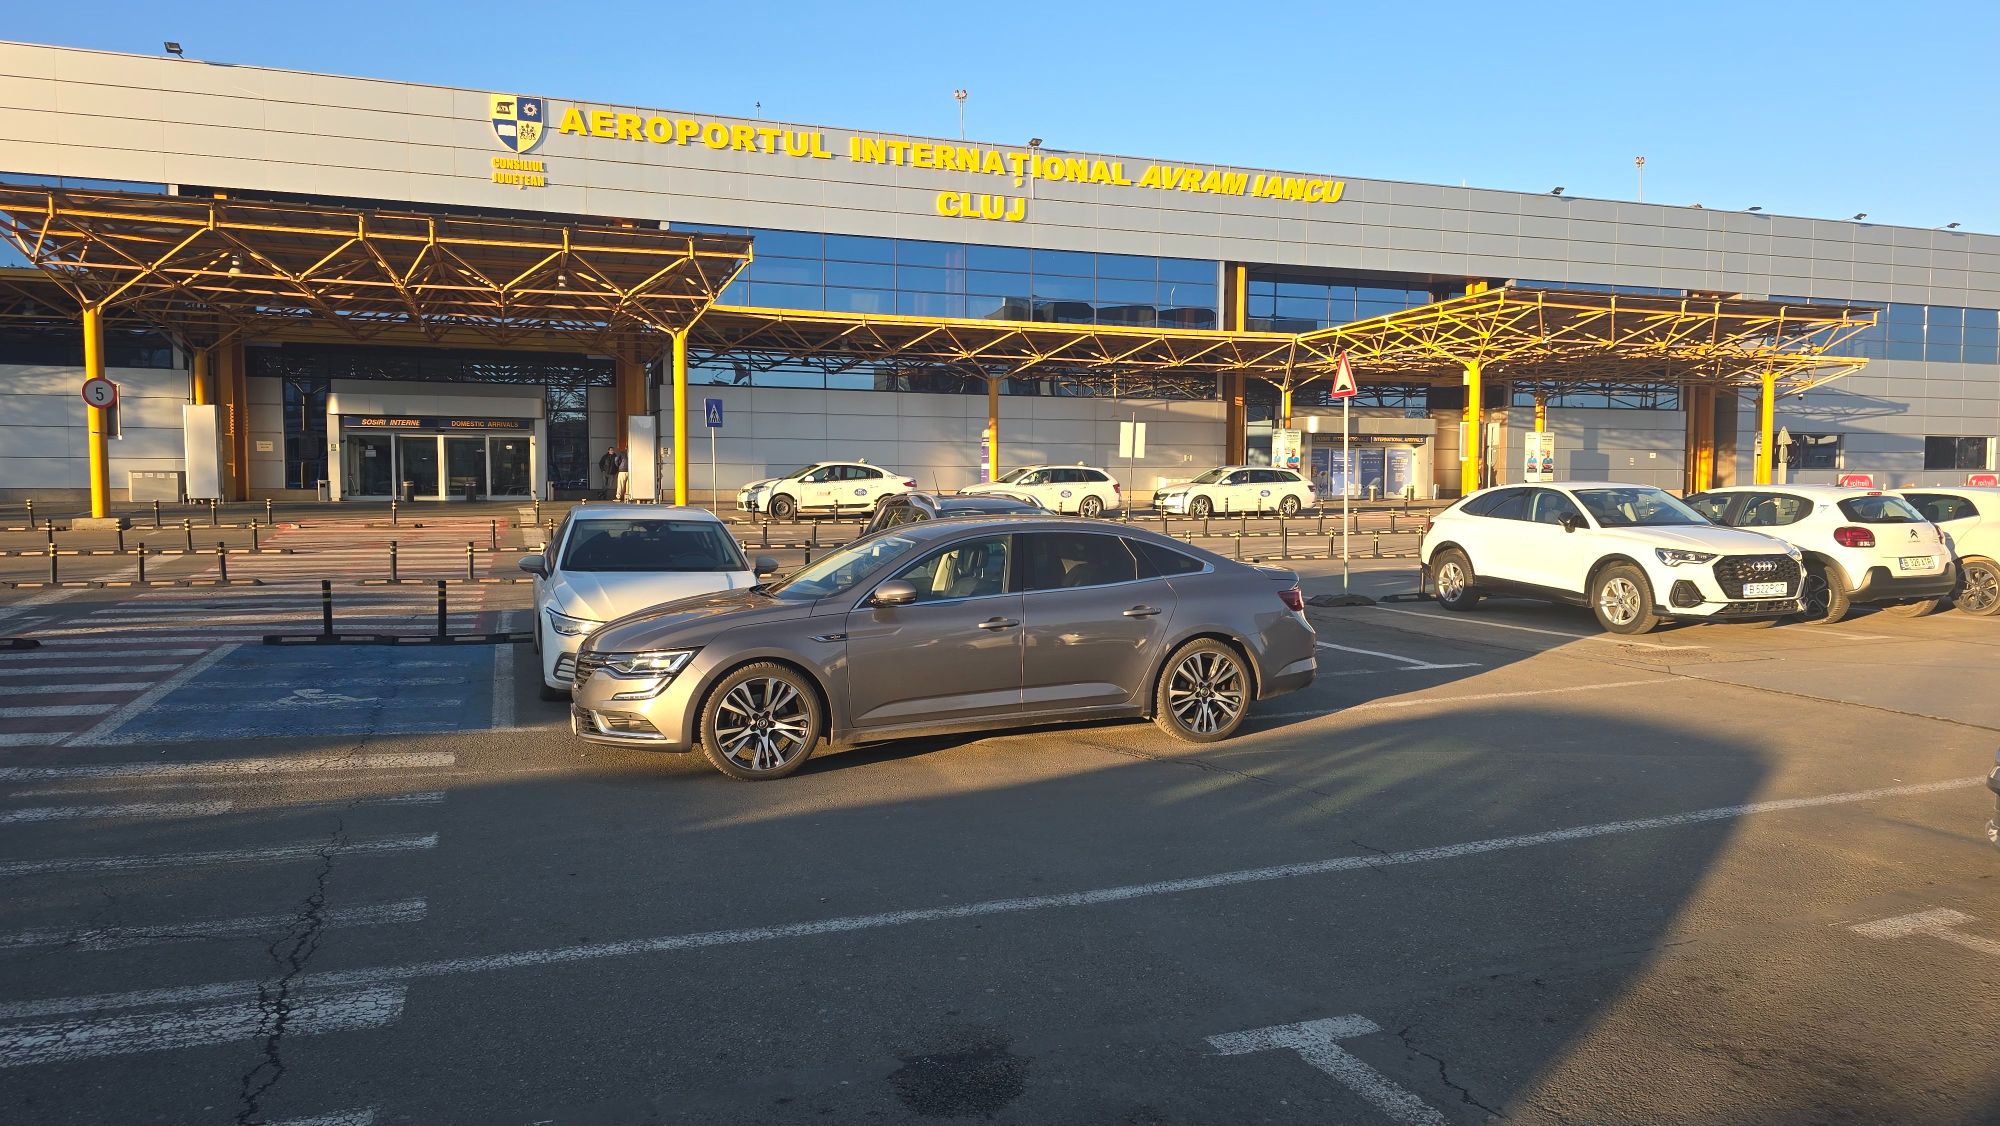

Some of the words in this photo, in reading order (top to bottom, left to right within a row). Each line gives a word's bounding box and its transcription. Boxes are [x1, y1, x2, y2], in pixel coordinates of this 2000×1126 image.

[559, 107, 832, 160] AEROPORTUL
[1137, 165, 1249, 197] AVRAM
[1252, 174, 1345, 204] IANCU
[491, 157, 545, 173] CONSILIUL
[936, 191, 1026, 222] CLUJ
[95, 387, 104, 401] 5
[361, 418, 387, 426] SOSIRI
[389, 419, 421, 427] INTERNE
[451, 420, 485, 428] DOMESTIC
